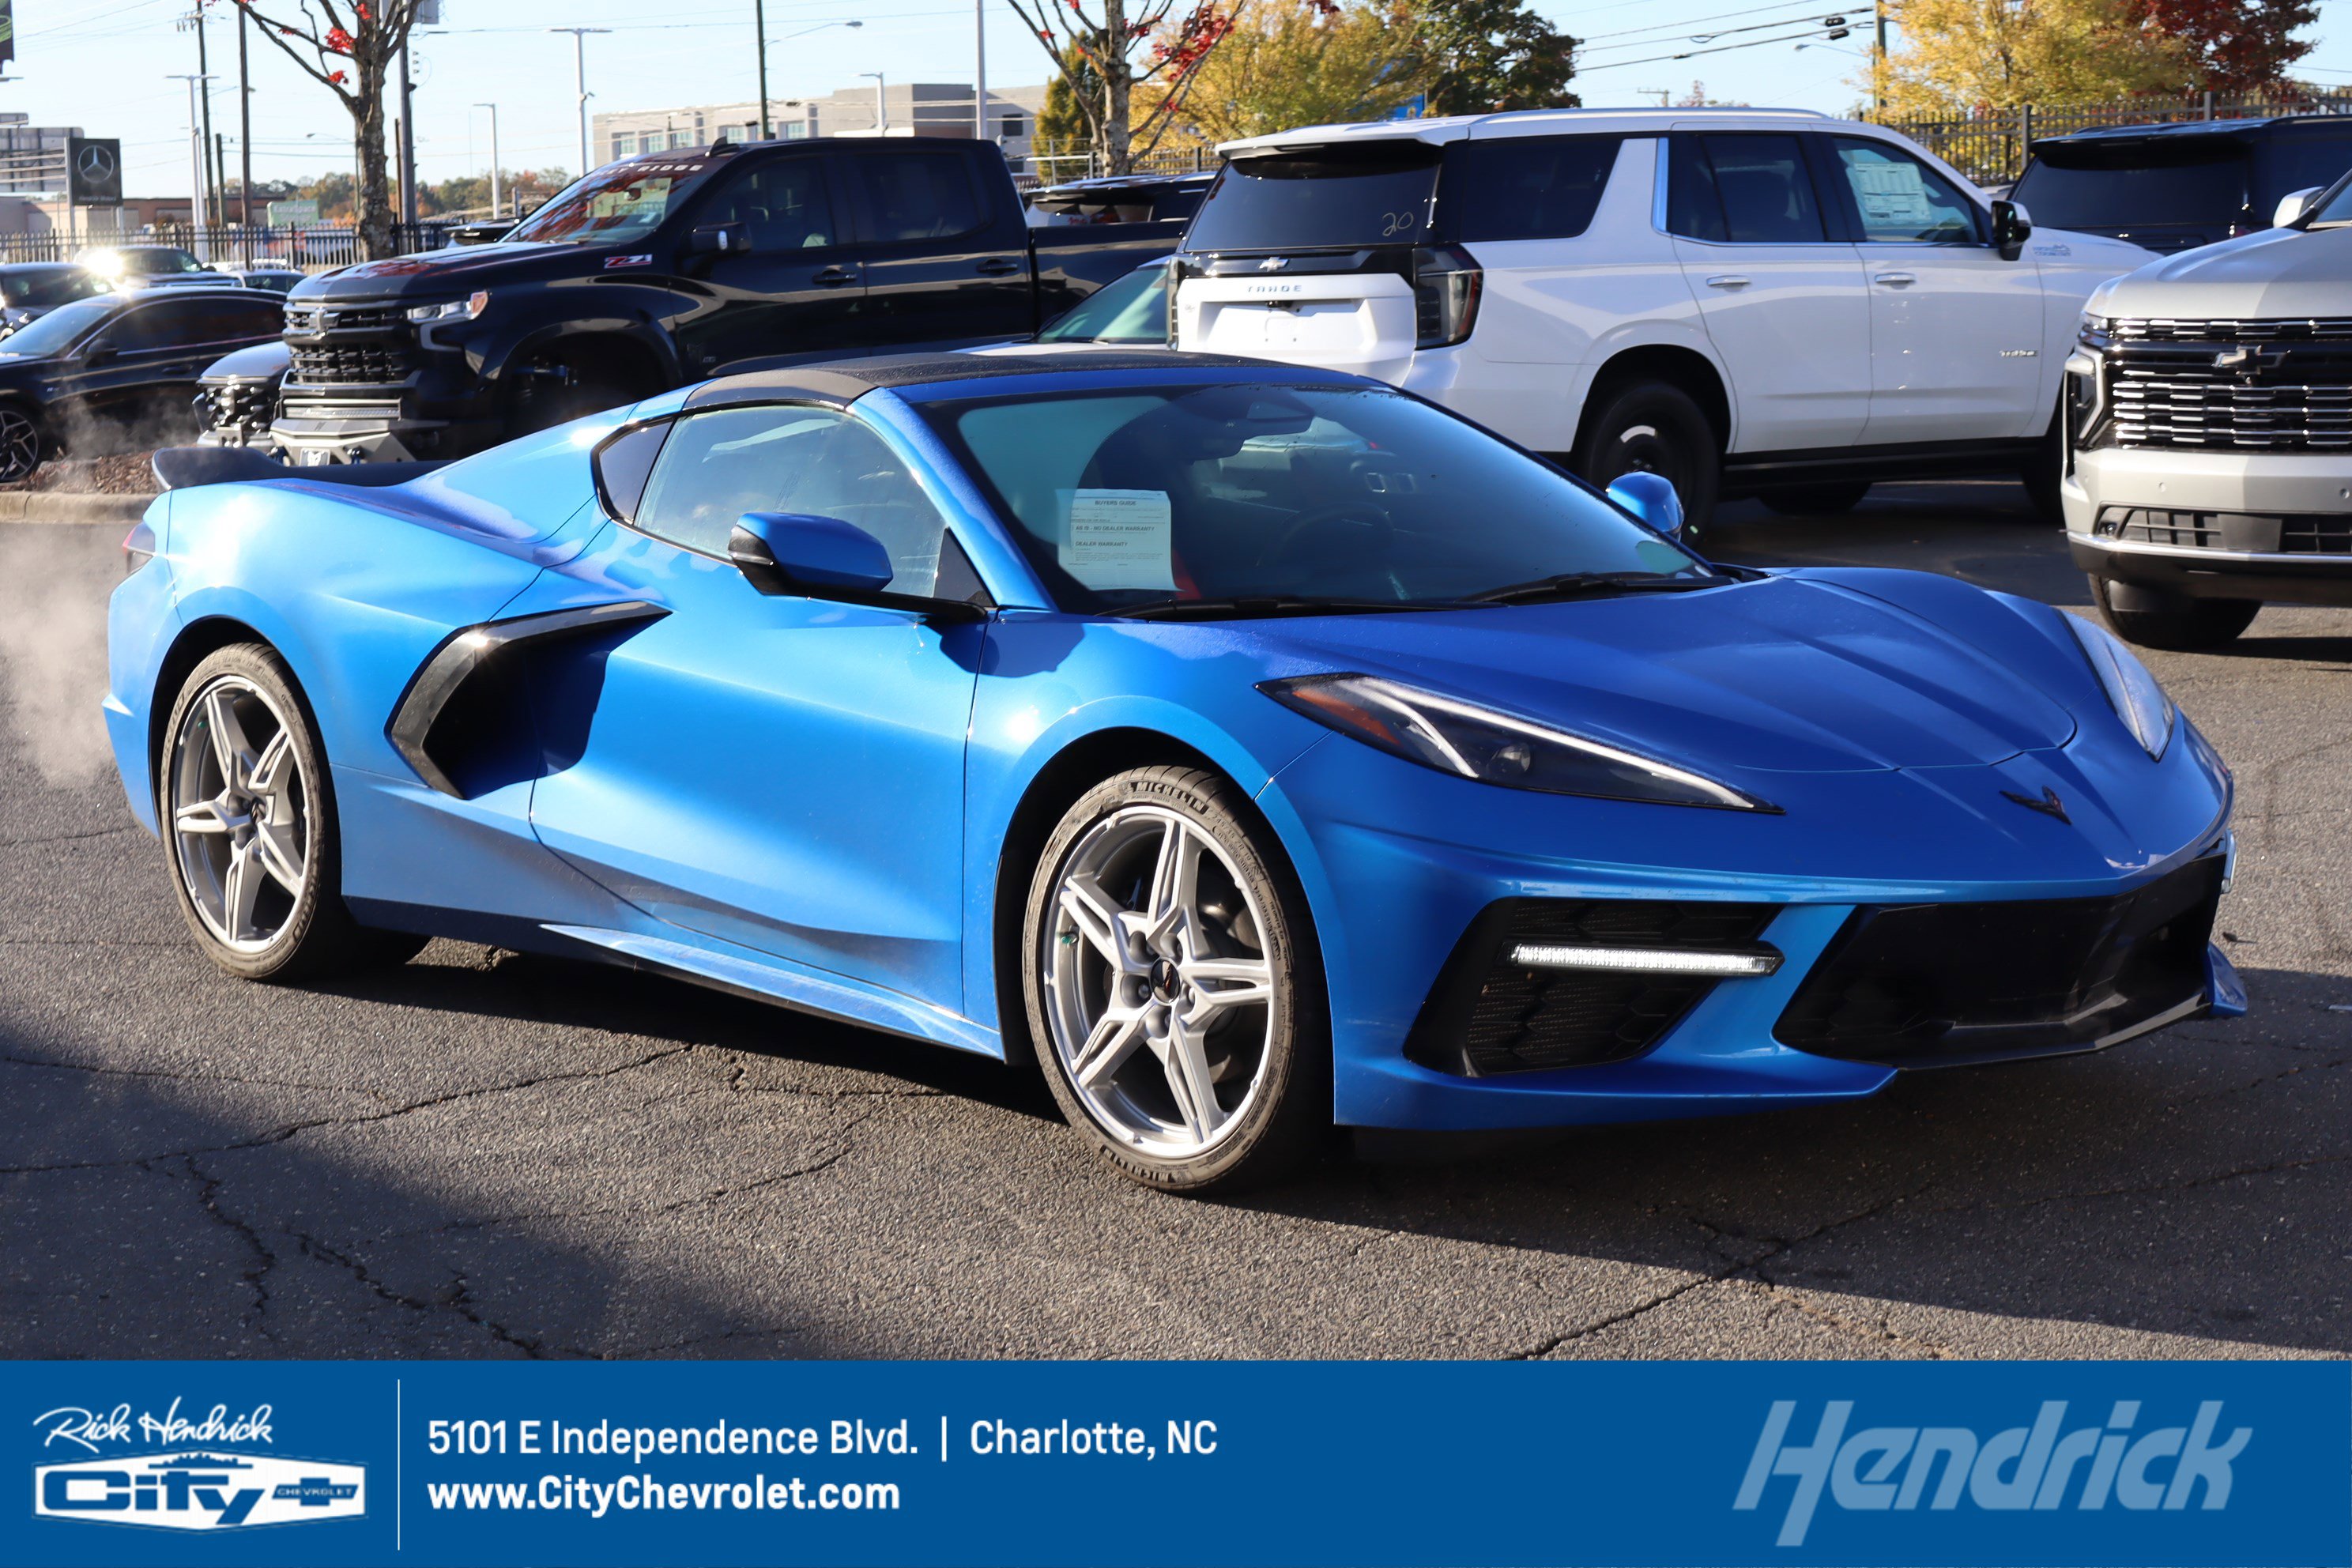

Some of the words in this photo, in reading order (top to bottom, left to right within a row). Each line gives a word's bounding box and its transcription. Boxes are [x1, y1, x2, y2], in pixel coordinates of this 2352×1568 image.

[1382, 211, 1414, 236] 20
[604, 254, 653, 270] Z71
[1136, 781, 1207, 813] MICHELIN
